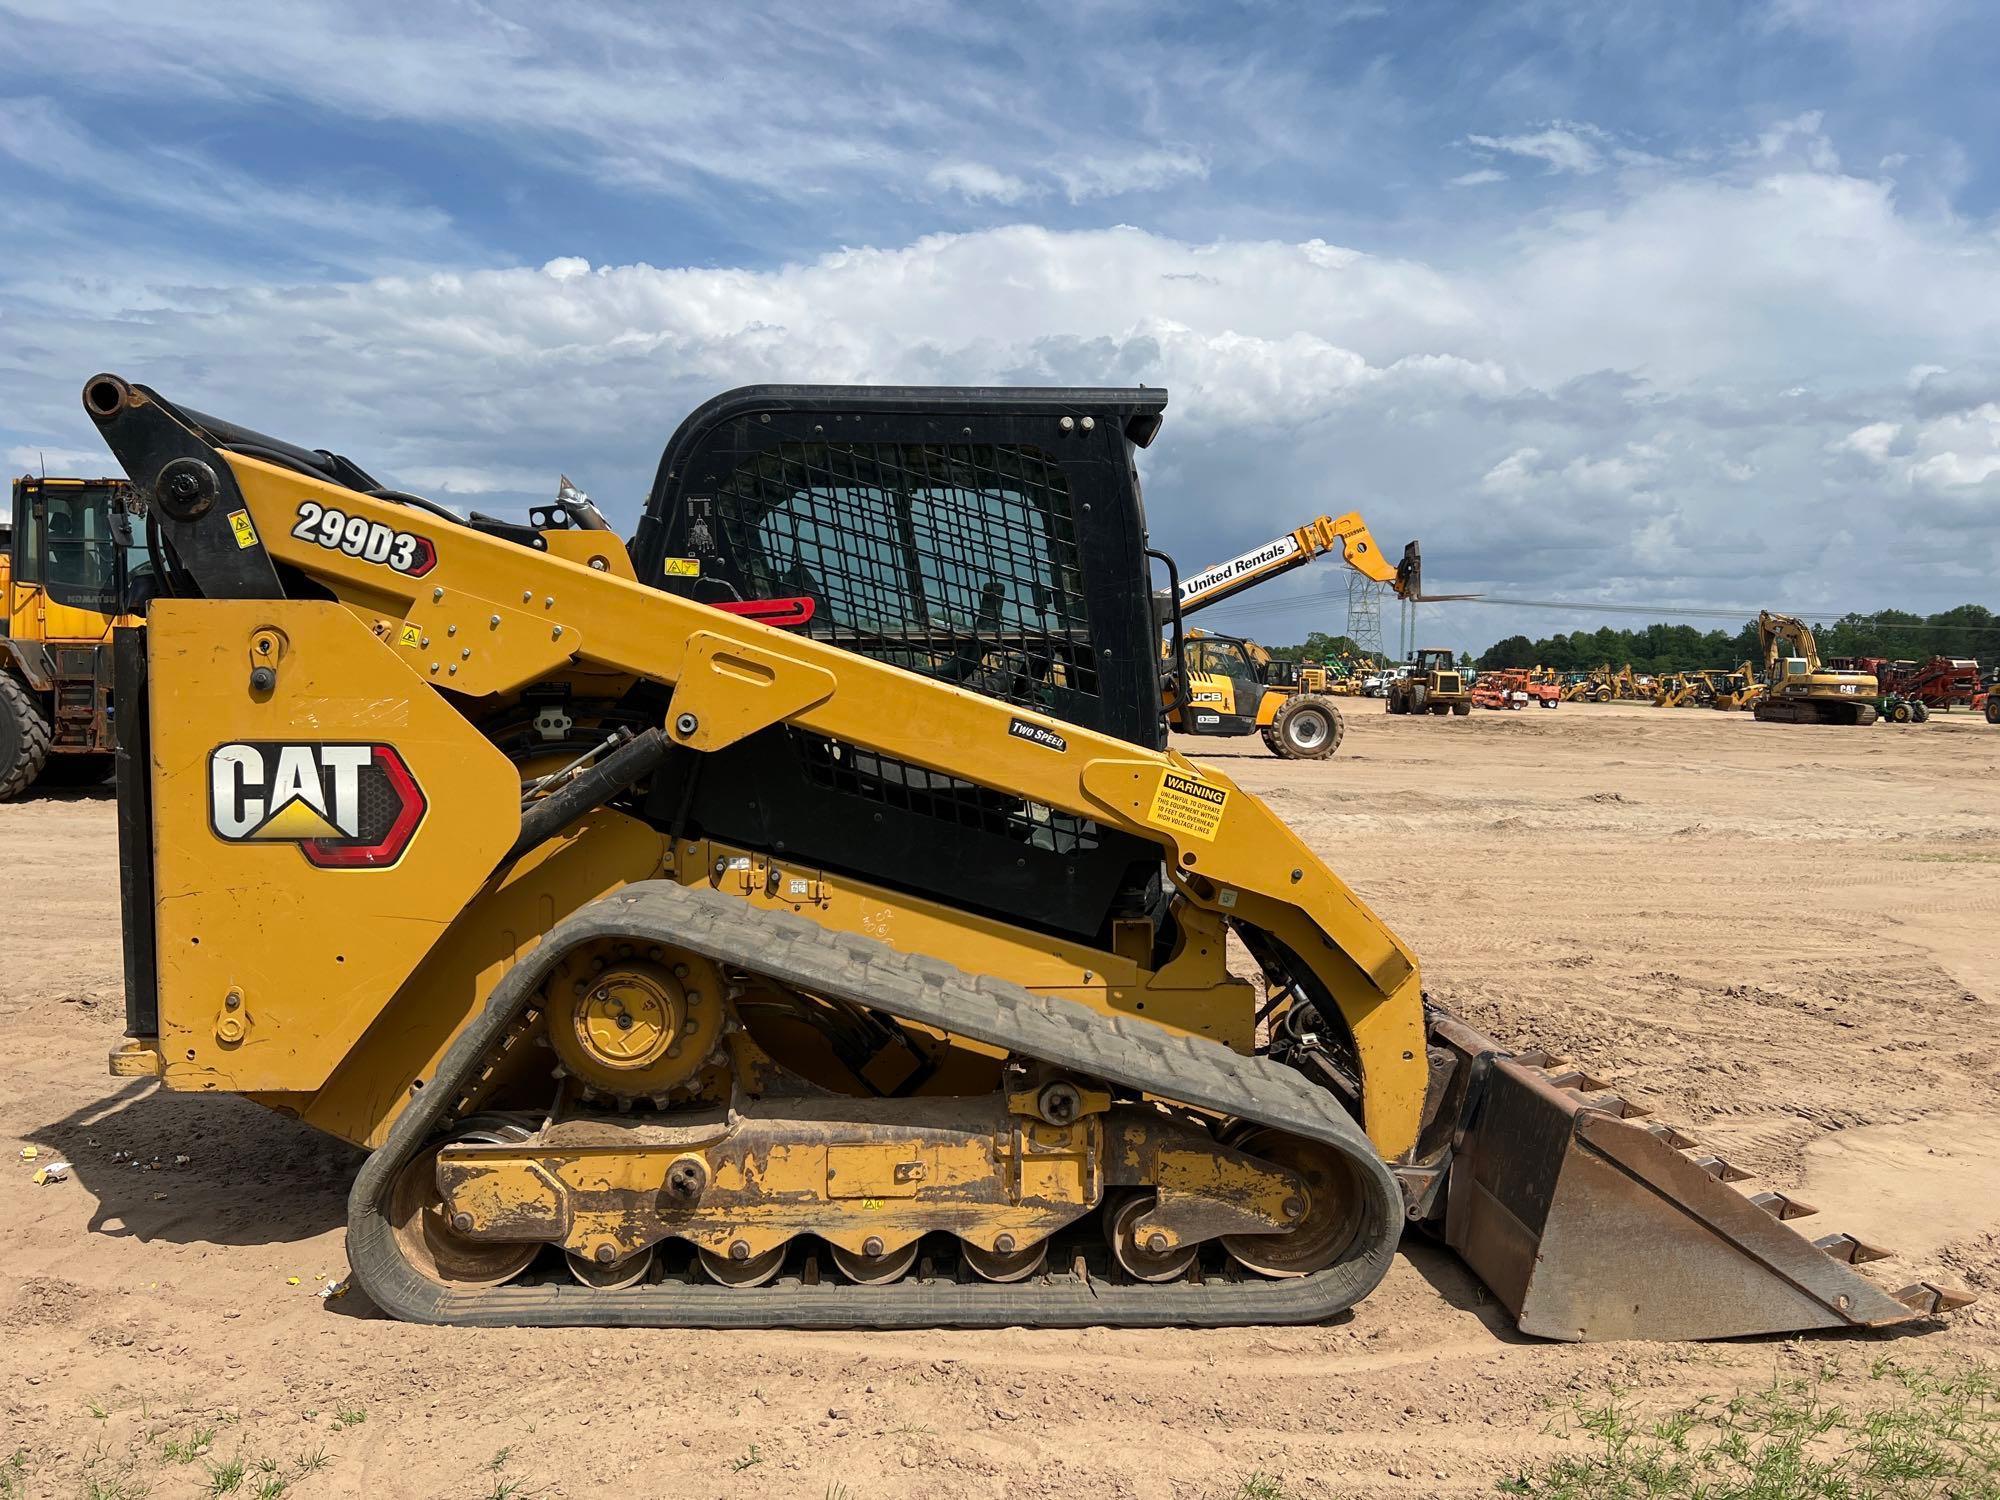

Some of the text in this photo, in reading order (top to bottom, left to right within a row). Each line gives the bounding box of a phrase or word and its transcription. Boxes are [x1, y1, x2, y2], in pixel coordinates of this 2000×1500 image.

[293, 502, 417, 570] 299D3
[1188, 545, 1285, 594] United Rentals
[1192, 693, 1222, 701] JCB
[1840, 685, 1856, 694] CAT
[1012, 722, 1064, 747] TWO SPEED
[213, 744, 371, 838] CAT
[1168, 776, 1223, 803] WARNING
[1157, 797, 1219, 822] THIS EQUIPMENT WITHIN
[1161, 791, 1188, 805] UNLAWFUL
[1197, 803, 1220, 814] OPERATE
[1157, 813, 1210, 835] HIGH VOLTAGE LINES
[1165, 808, 1177, 816] FEET
[1187, 815, 1214, 828] OVERHEAD
